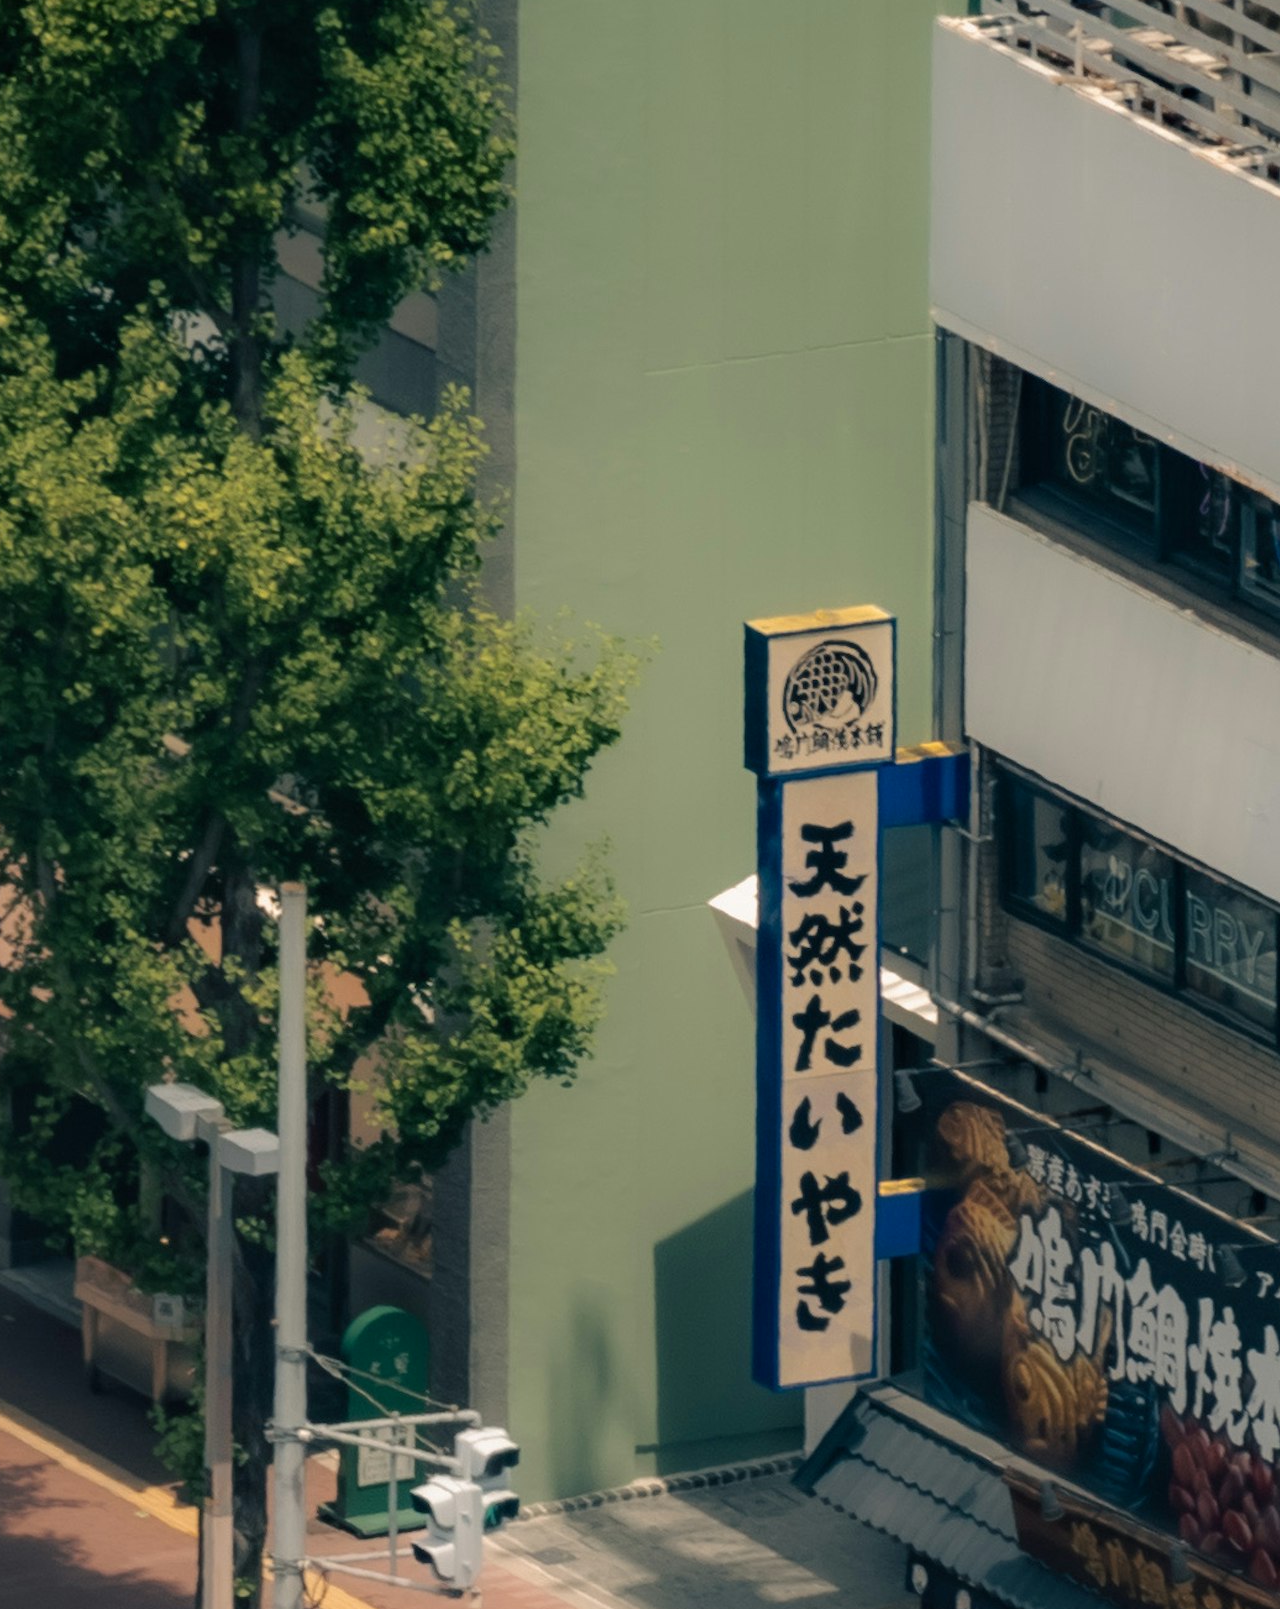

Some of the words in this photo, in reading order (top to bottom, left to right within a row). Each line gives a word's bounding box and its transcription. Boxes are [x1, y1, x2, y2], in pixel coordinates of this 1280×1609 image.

[788, 820, 869, 1333] 天然たいやき
